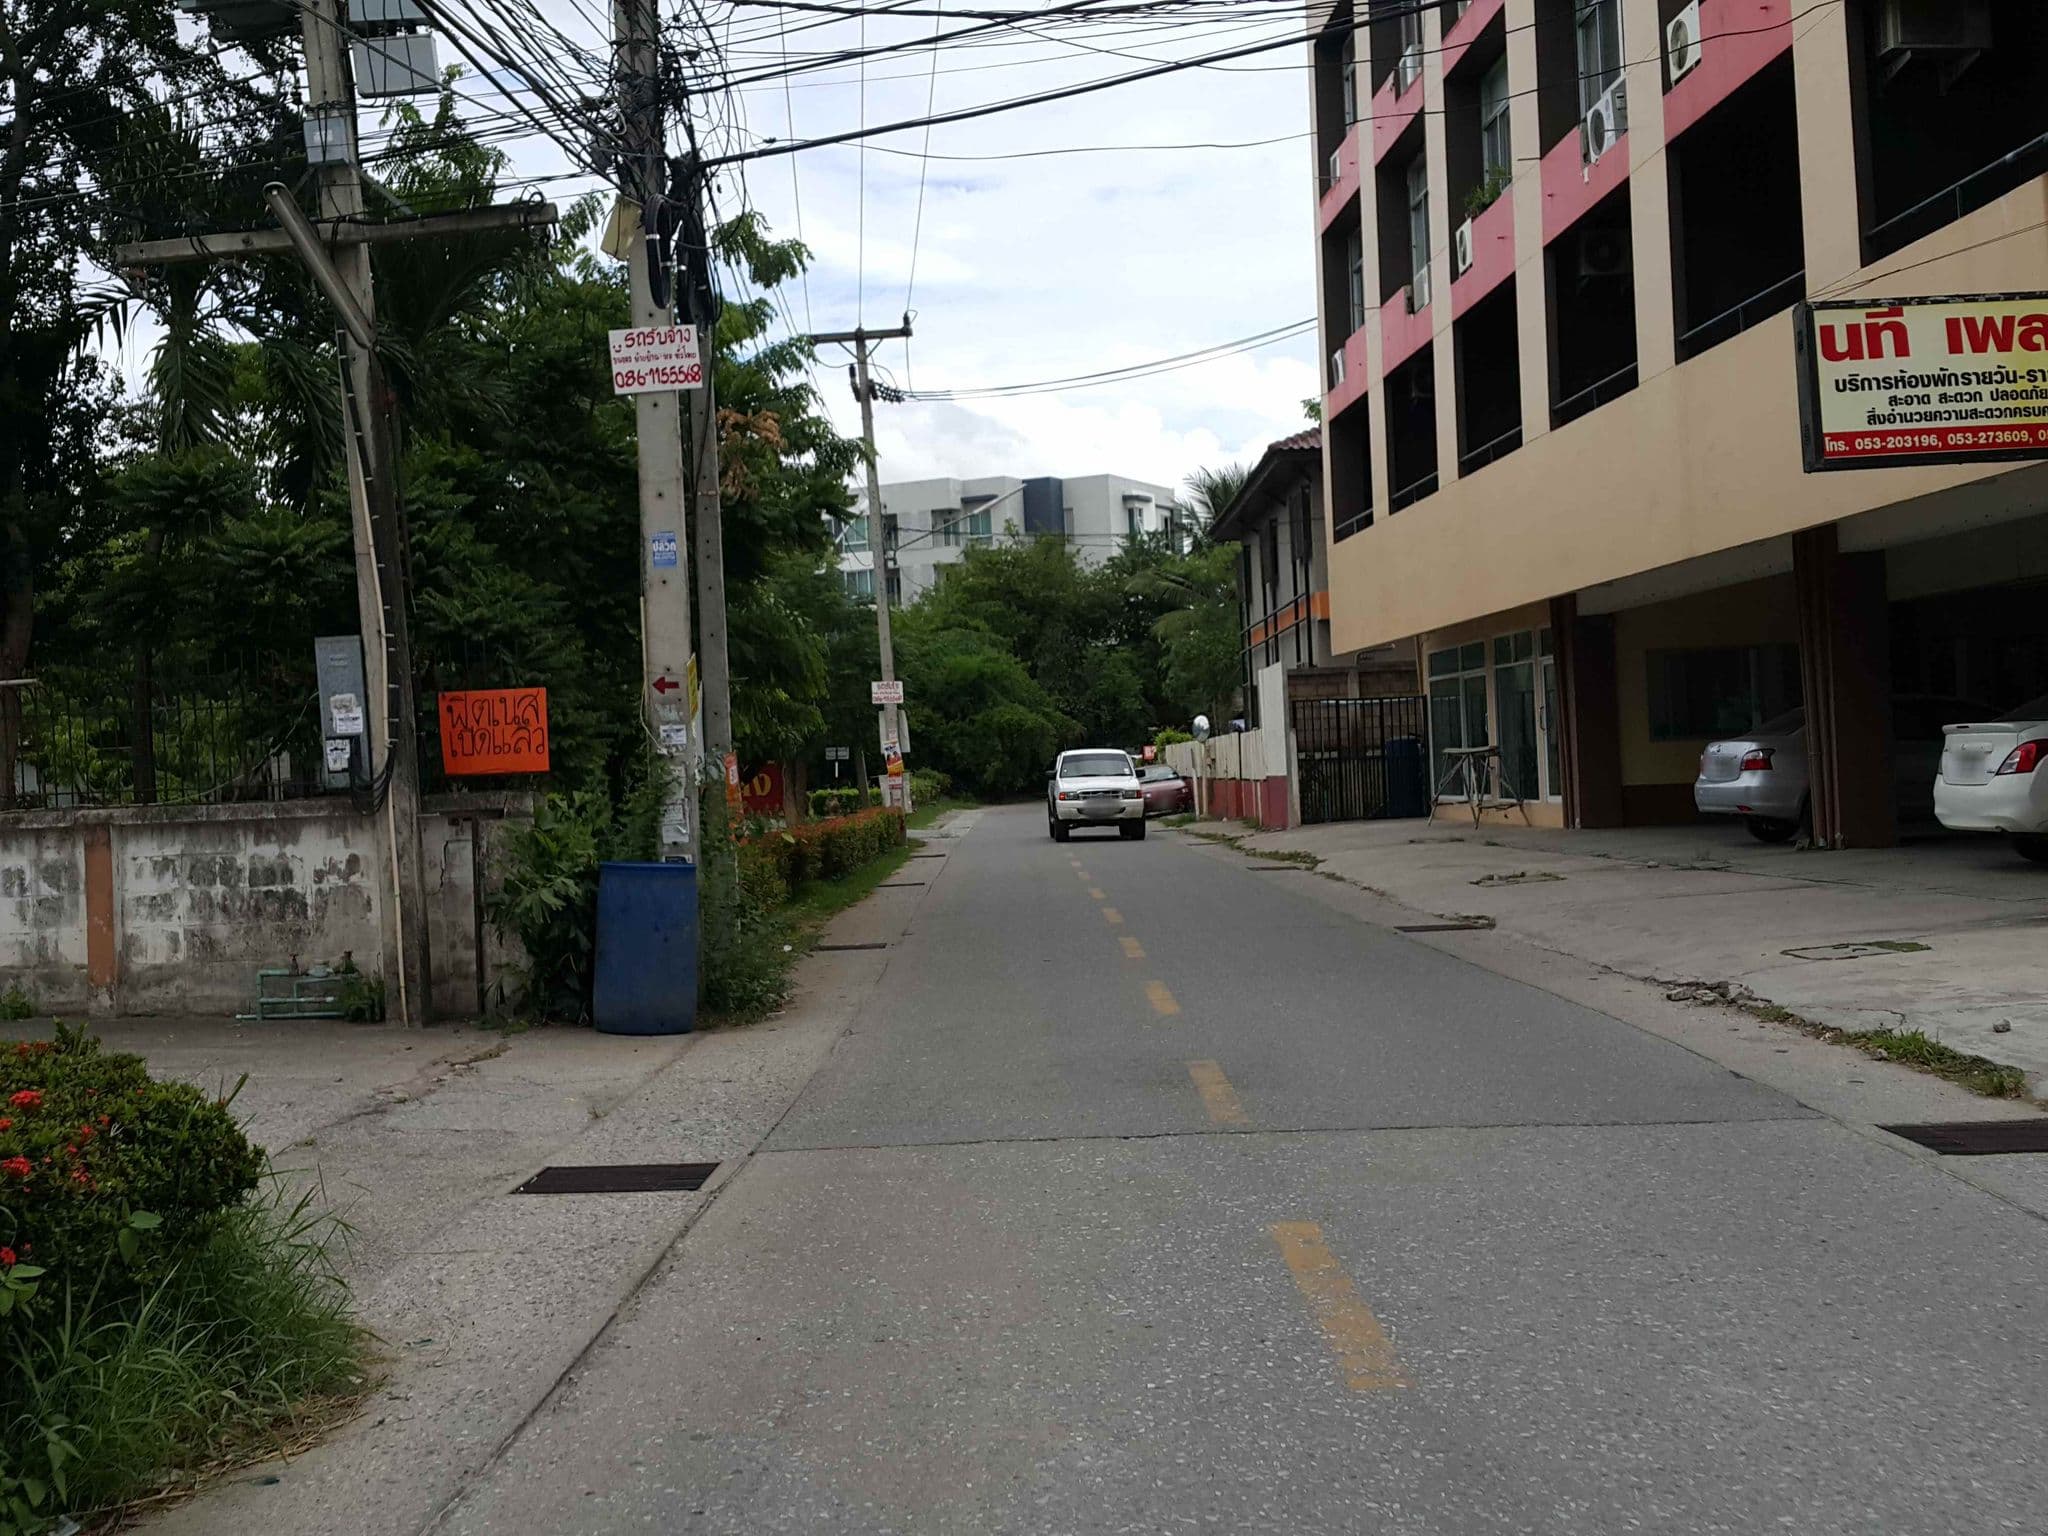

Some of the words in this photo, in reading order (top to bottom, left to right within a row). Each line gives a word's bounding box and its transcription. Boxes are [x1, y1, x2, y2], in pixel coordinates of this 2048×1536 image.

[624, 327, 691, 348] รถรับจ้าง
[615, 363, 701, 388] 086-1155568
[1834, 366, 2048, 392] บริการห้องพักรายวัน-รา
[1888, 393, 1931, 407] สะอาด
[1938, 390, 1983, 404] สะดวก
[1990, 385, 2048, 402] ปลอดภัย
[1824, 436, 1850, 452] โทร.
[1855, 433, 1942, 450] 053-203196,
[1947, 430, 2033, 446] 053-273609,
[446, 690, 541, 729] ฟิตเนส
